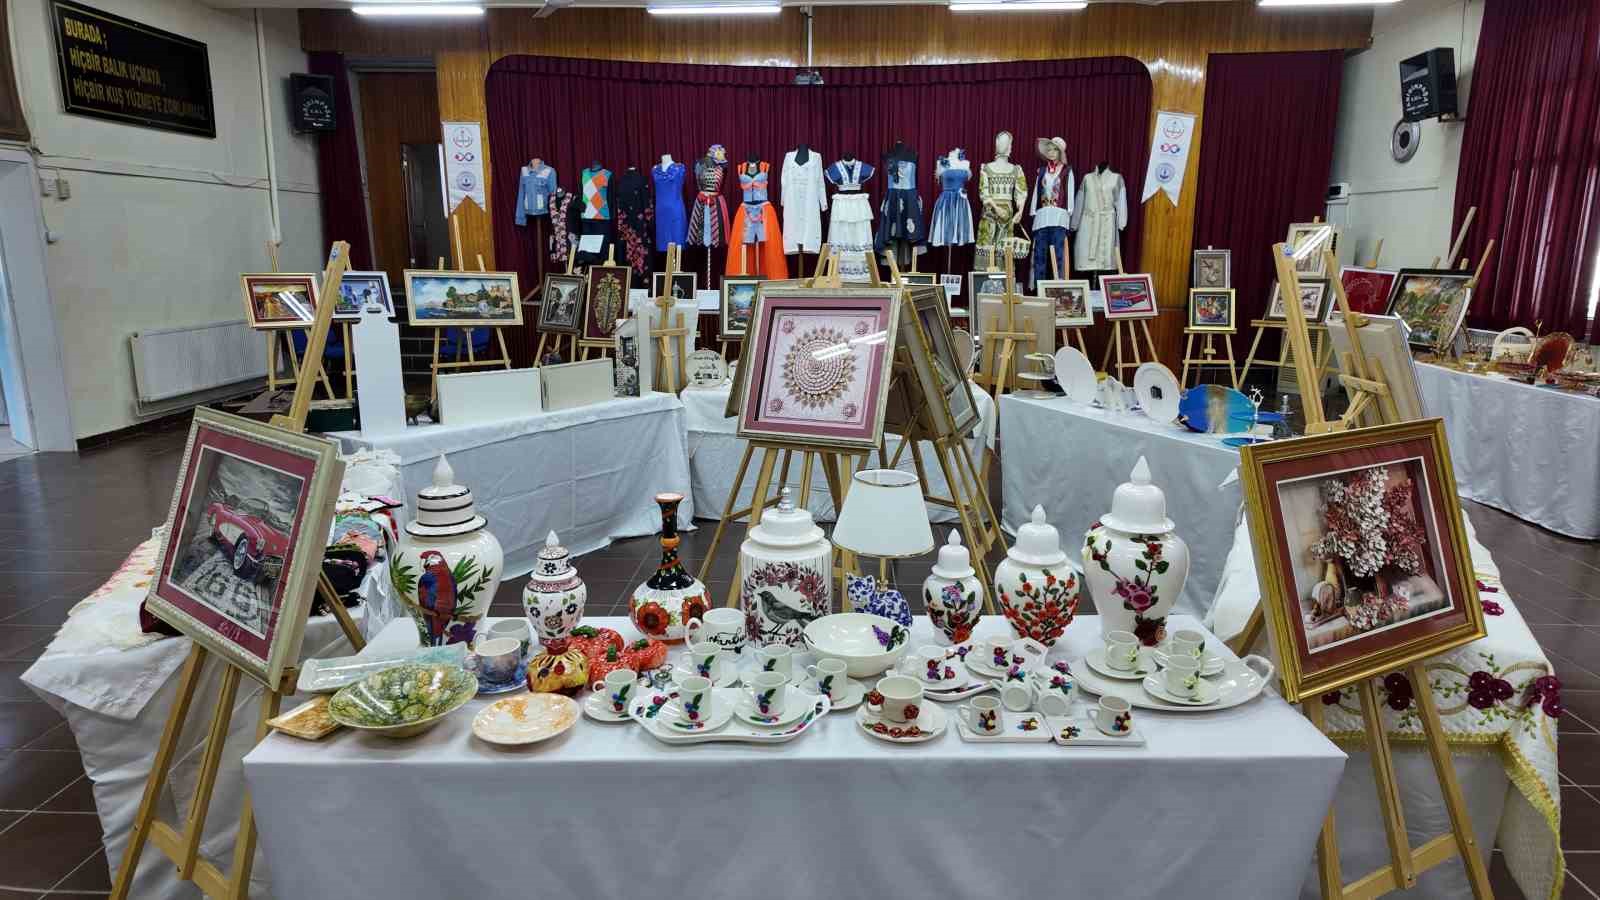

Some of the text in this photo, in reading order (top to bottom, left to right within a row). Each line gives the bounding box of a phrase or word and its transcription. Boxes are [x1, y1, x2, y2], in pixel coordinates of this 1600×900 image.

[70, 46, 102, 74] HİÇBİR
[102, 55, 128, 79] BALIK
[73, 75, 105, 103] HİÇBİR
[106, 83, 124, 110] KUŞ
